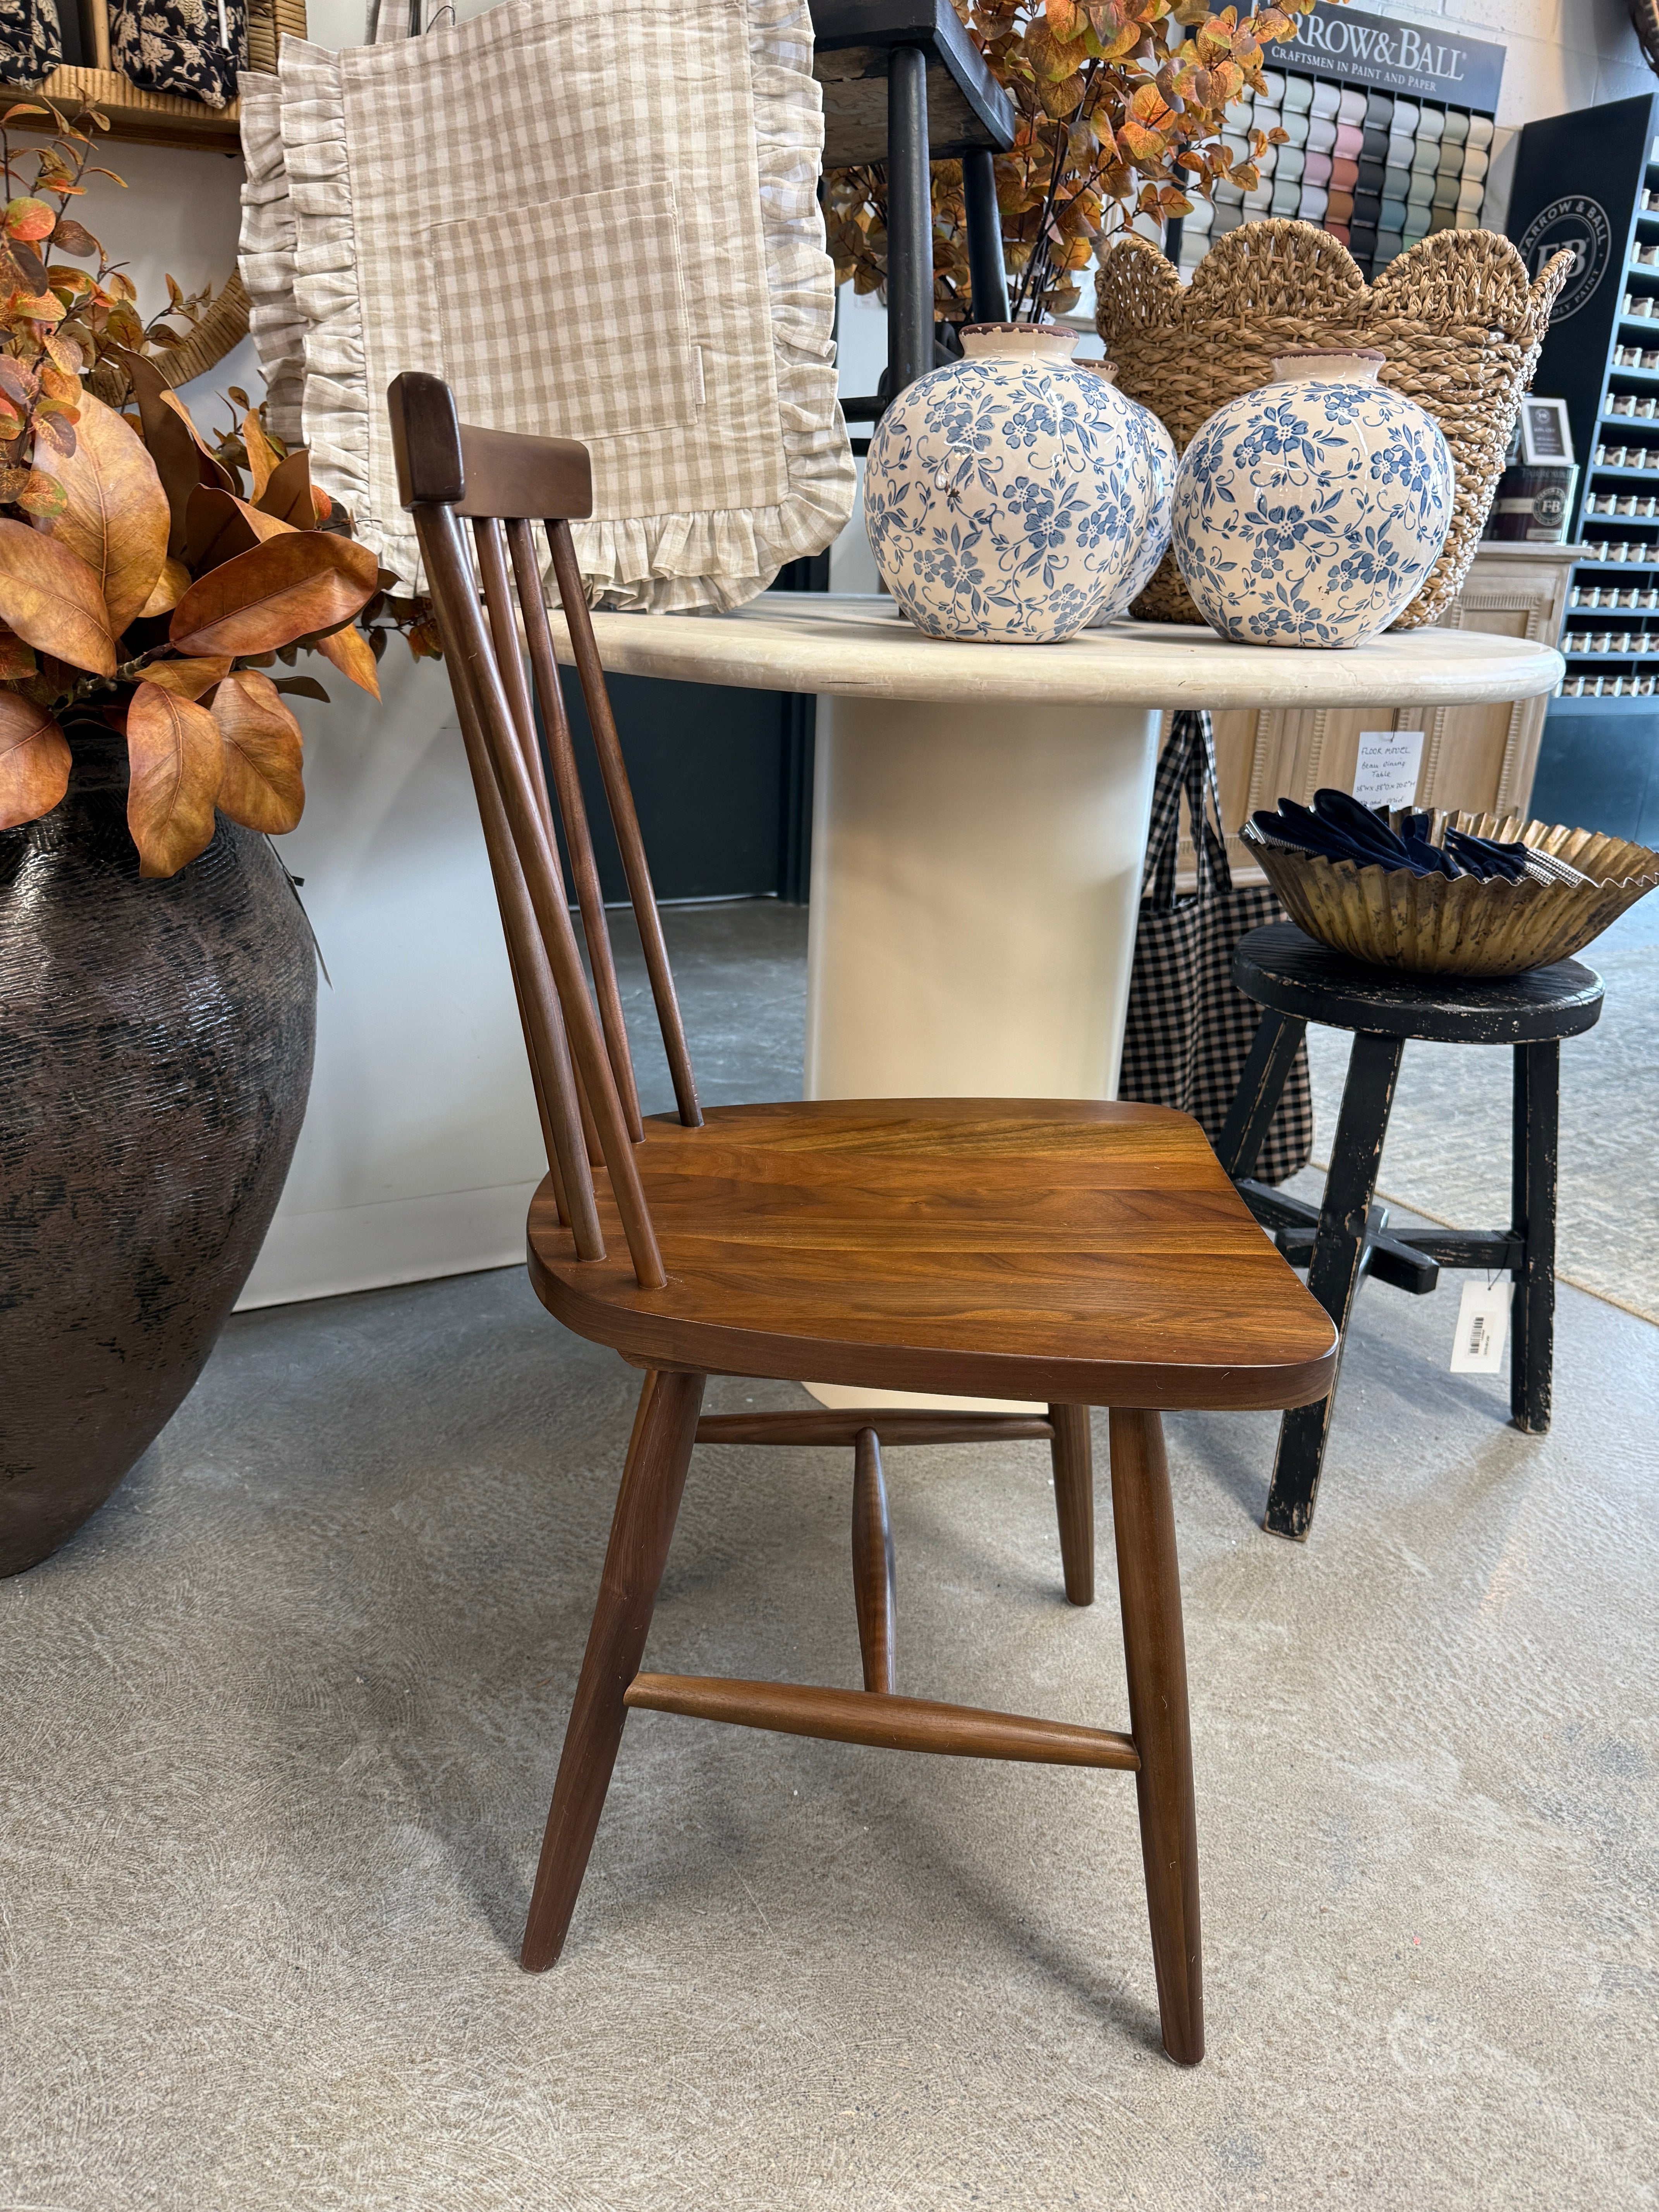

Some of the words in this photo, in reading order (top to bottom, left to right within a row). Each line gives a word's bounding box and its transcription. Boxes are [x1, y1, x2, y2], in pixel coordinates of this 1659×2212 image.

[1288, 12, 1465, 81] RROW&BALL
[1271, 46, 1334, 69] CRAFTSMEN
[1337, 61, 1349, 72] IN
[1351, 63, 1381, 80] PAINT
[1384, 72, 1405, 84] AND
[1408, 76, 1437, 92] PAPER
[1576, 201, 1585, 213] &
[1587, 206, 1607, 245] BALL
[1541, 500, 1561, 514] FB
[1384, 746, 1411, 754] MODEL
